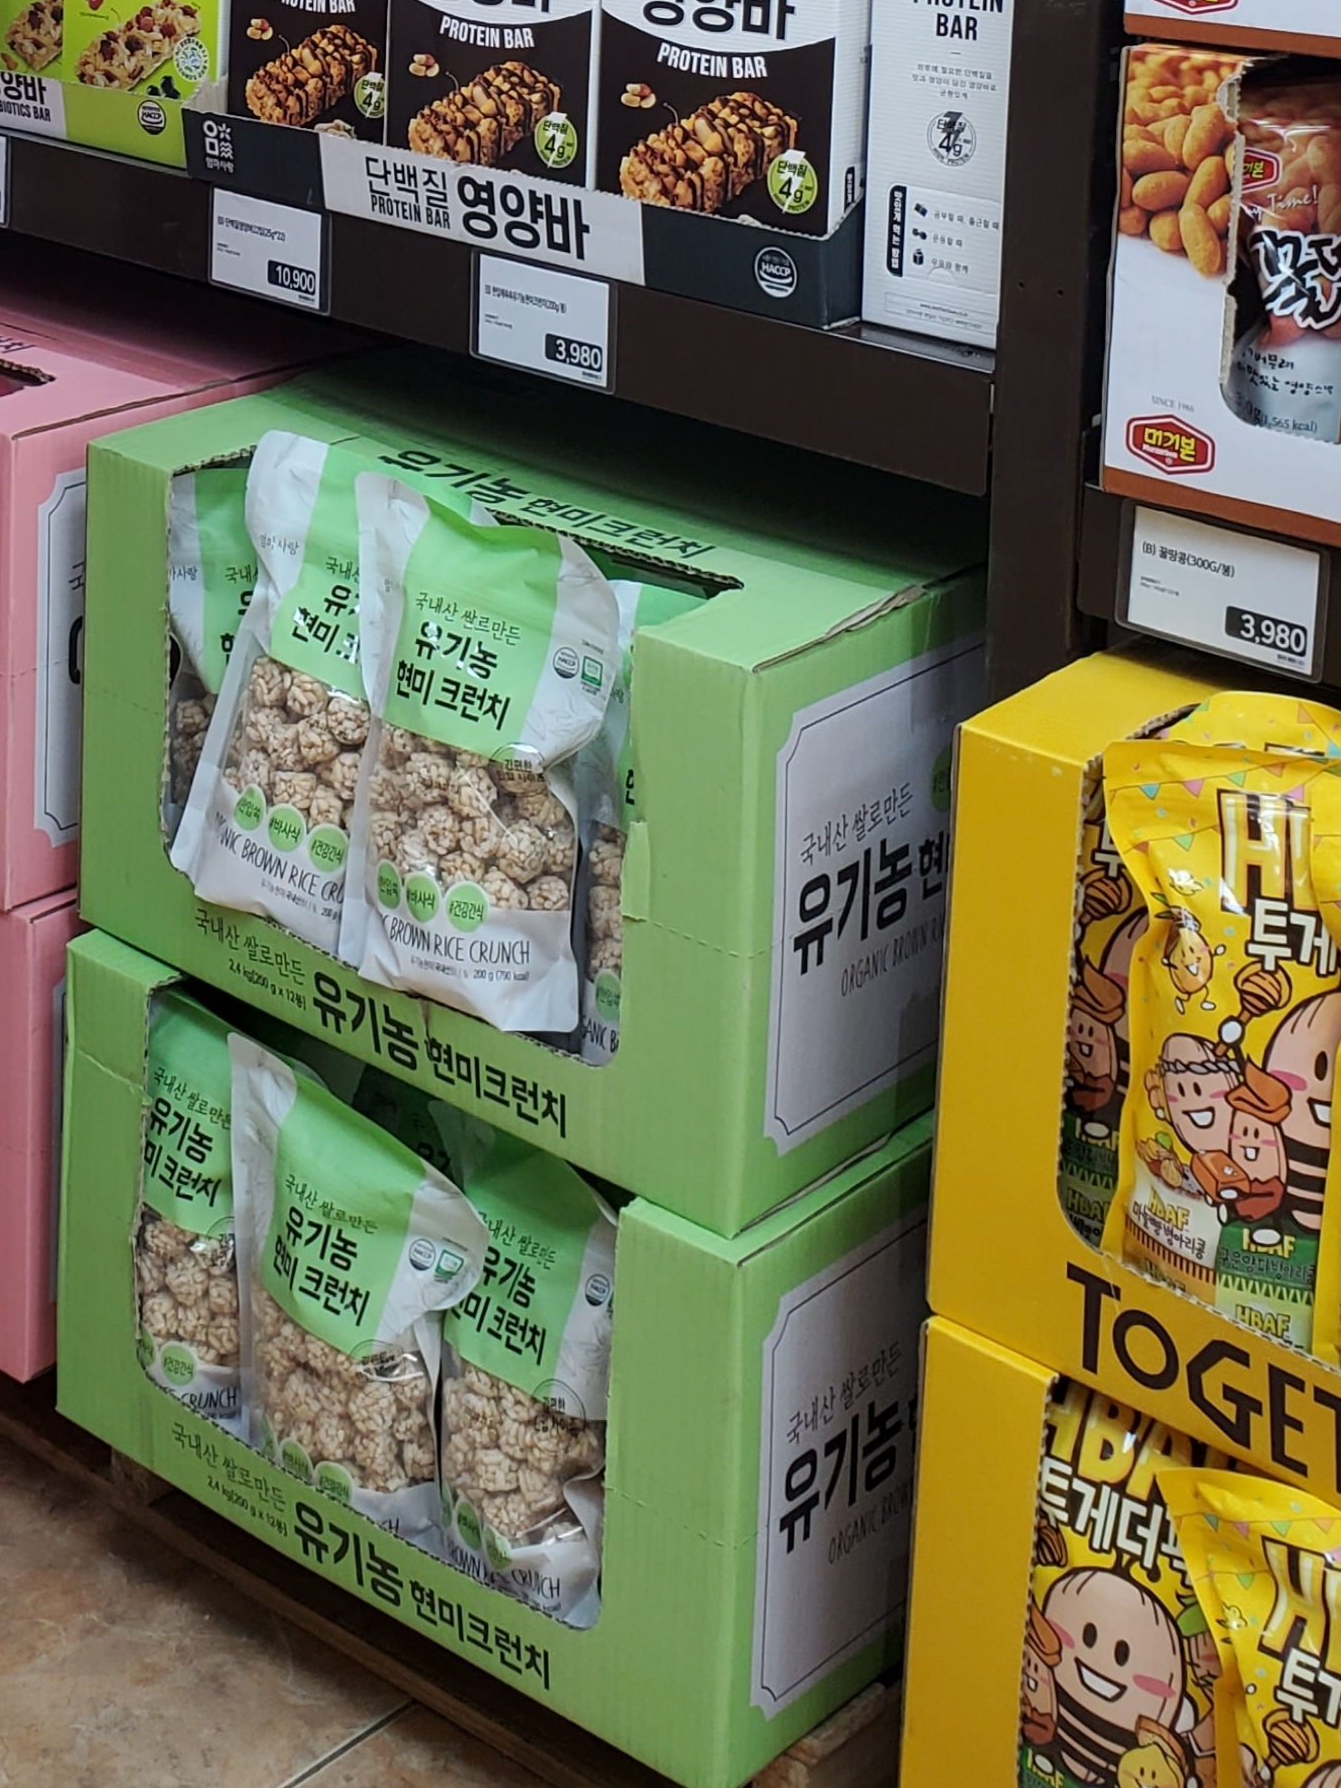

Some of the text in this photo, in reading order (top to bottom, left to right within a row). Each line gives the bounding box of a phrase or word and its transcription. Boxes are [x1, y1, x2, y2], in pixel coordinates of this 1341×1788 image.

[439, 15, 535, 49] PROTEIN BAR
[935, 13, 978, 41] BAR
[657, 41, 768, 79] PROTEIN BAR
[33, 105, 52, 123] BAR
[365, 156, 448, 210] 단백질
[371, 192, 451, 230] PROTEIN BAR
[458, 175, 590, 261] 영양바
[274, 265, 315, 294] 10,900
[762, 263, 791, 277] HACCP
[554, 338, 601, 371] 3,980
[1151, 394, 1175, 410] SINCE
[1143, 426, 1197, 463] 머거본
[378, 450, 715, 559] 유기농 현미크런치
[1142, 541, 1236, 578] (B) 꿀땅콩(300G/봉)
[415, 592, 458, 622] 국내산
[1240, 613, 1307, 654] 3,980
[415, 620, 499, 680] 유기농
[395, 659, 511, 731] 현미 크런치
[800, 782, 913, 866] 국내산 쌀로만든
[240, 839, 287, 880] BROWN
[288, 862, 319, 899] RICE
[793, 837, 912, 977] 유기농
[195, 908, 306, 987] 국내산 쌀로만든
[389, 915, 530, 965] BROWN RICE CRUNCH
[841, 923, 929, 996] ORGANIC BROWN
[312, 970, 567, 1139] 유기농 현미크런치
[153, 1067, 232, 1131] 국내산 쌀로만든
[149, 1096, 214, 1164] 유기농
[158, 1155, 223, 1208] 크런치
[285, 1173, 379, 1235] 국내산 쌀로만든
[285, 1206, 359, 1272] 유기농
[273, 1234, 370, 1327] 현미 크런치
[487, 1312, 548, 1366] 크런치
[1234, 1304, 1291, 1339] HBAF
[785, 1341, 903, 1445] 국내산 쌀로만든
[171, 1421, 287, 1513] 국내산 쌀로만든
[778, 1398, 907, 1556] 유기농
[827, 1506, 878, 1566] ORGANIC
[293, 1501, 551, 1691] 유기농 현미크런치
